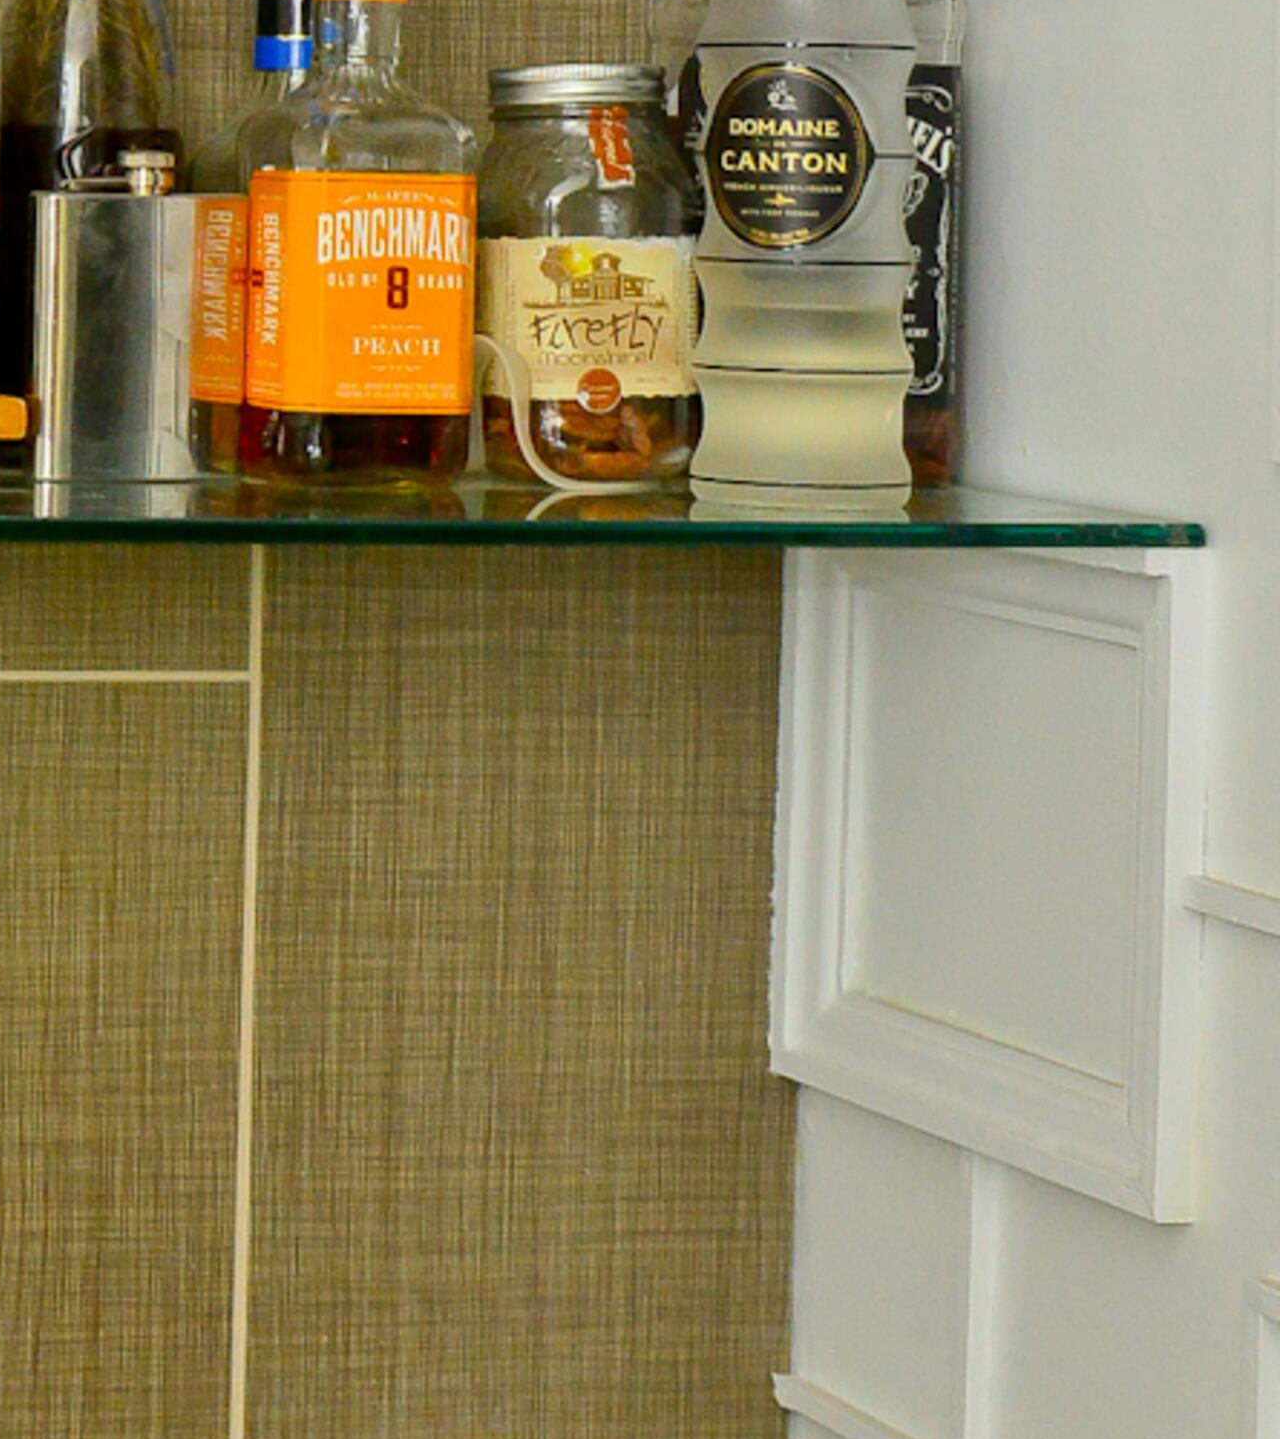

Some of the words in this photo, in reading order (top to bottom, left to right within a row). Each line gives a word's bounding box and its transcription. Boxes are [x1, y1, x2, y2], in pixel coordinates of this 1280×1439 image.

[729, 117, 840, 138] DOMAINE
[720, 149, 849, 174] CANTON
[260, 211, 282, 346] BENCHMARK
[386, 266, 409, 310] 8
[351, 335, 441, 357] PEACH
